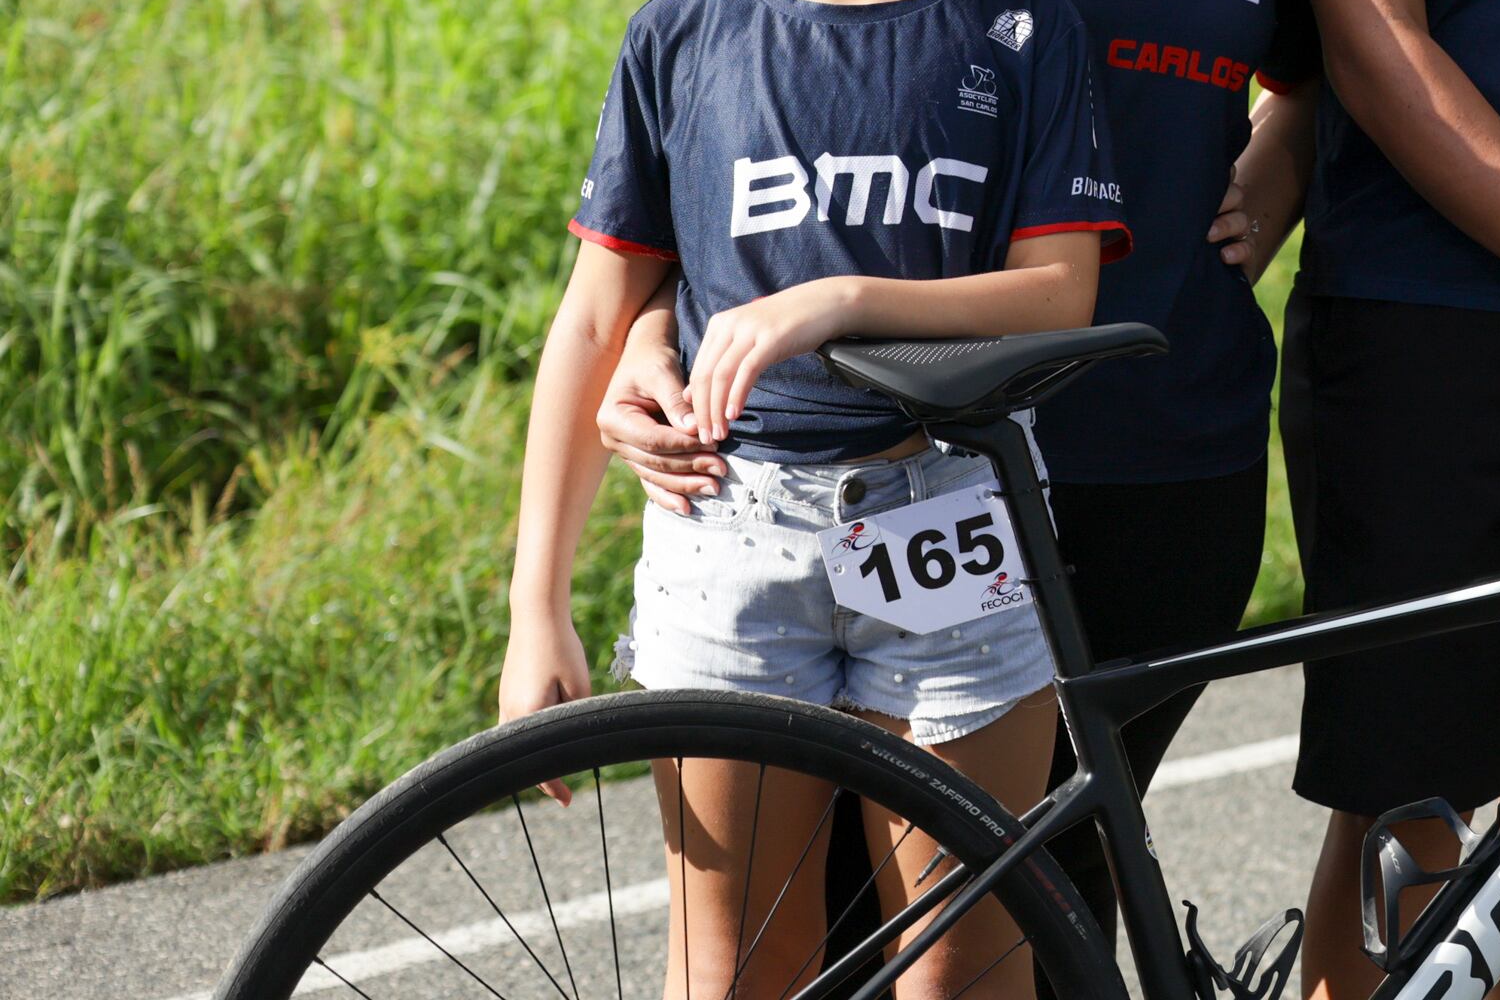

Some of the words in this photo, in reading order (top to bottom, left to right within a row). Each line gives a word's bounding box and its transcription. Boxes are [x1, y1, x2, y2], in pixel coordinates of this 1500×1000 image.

[1106, 39, 1249, 92] CARLOS
[730, 152, 989, 238] BMC
[859, 512, 1004, 603] 165
[981, 592, 1024, 612] FECOCI
[929, 778, 981, 817] ZAFFIRO
[979, 814, 1006, 838] PRO
